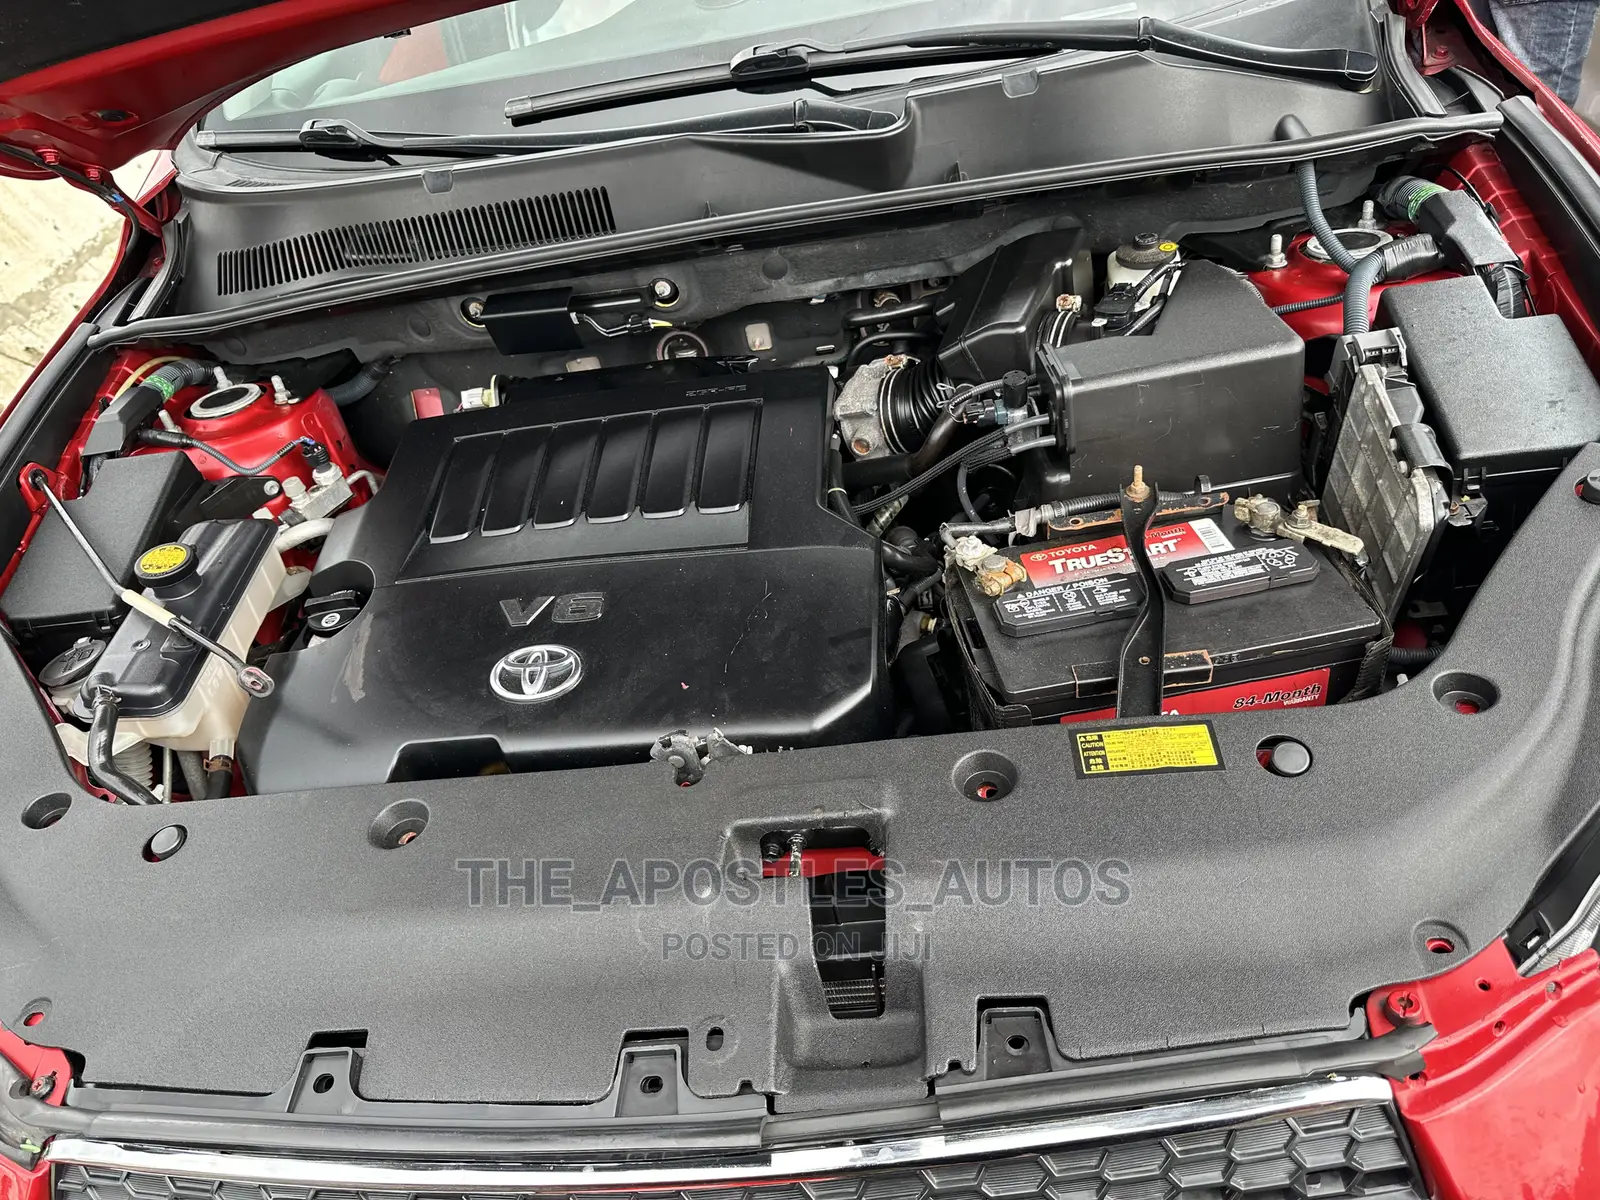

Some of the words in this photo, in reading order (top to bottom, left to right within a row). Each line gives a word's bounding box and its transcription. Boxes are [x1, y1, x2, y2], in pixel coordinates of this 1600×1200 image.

[1048, 544, 1097, 558] TOYOTA
[1025, 585, 1064, 598] DANGER
[499, 592, 606, 628] V6
[1232, 684, 1322, 709] 84-Month
[1283, 694, 1320, 706] WARRANTY
[1081, 741, 1105, 749] CAUTION
